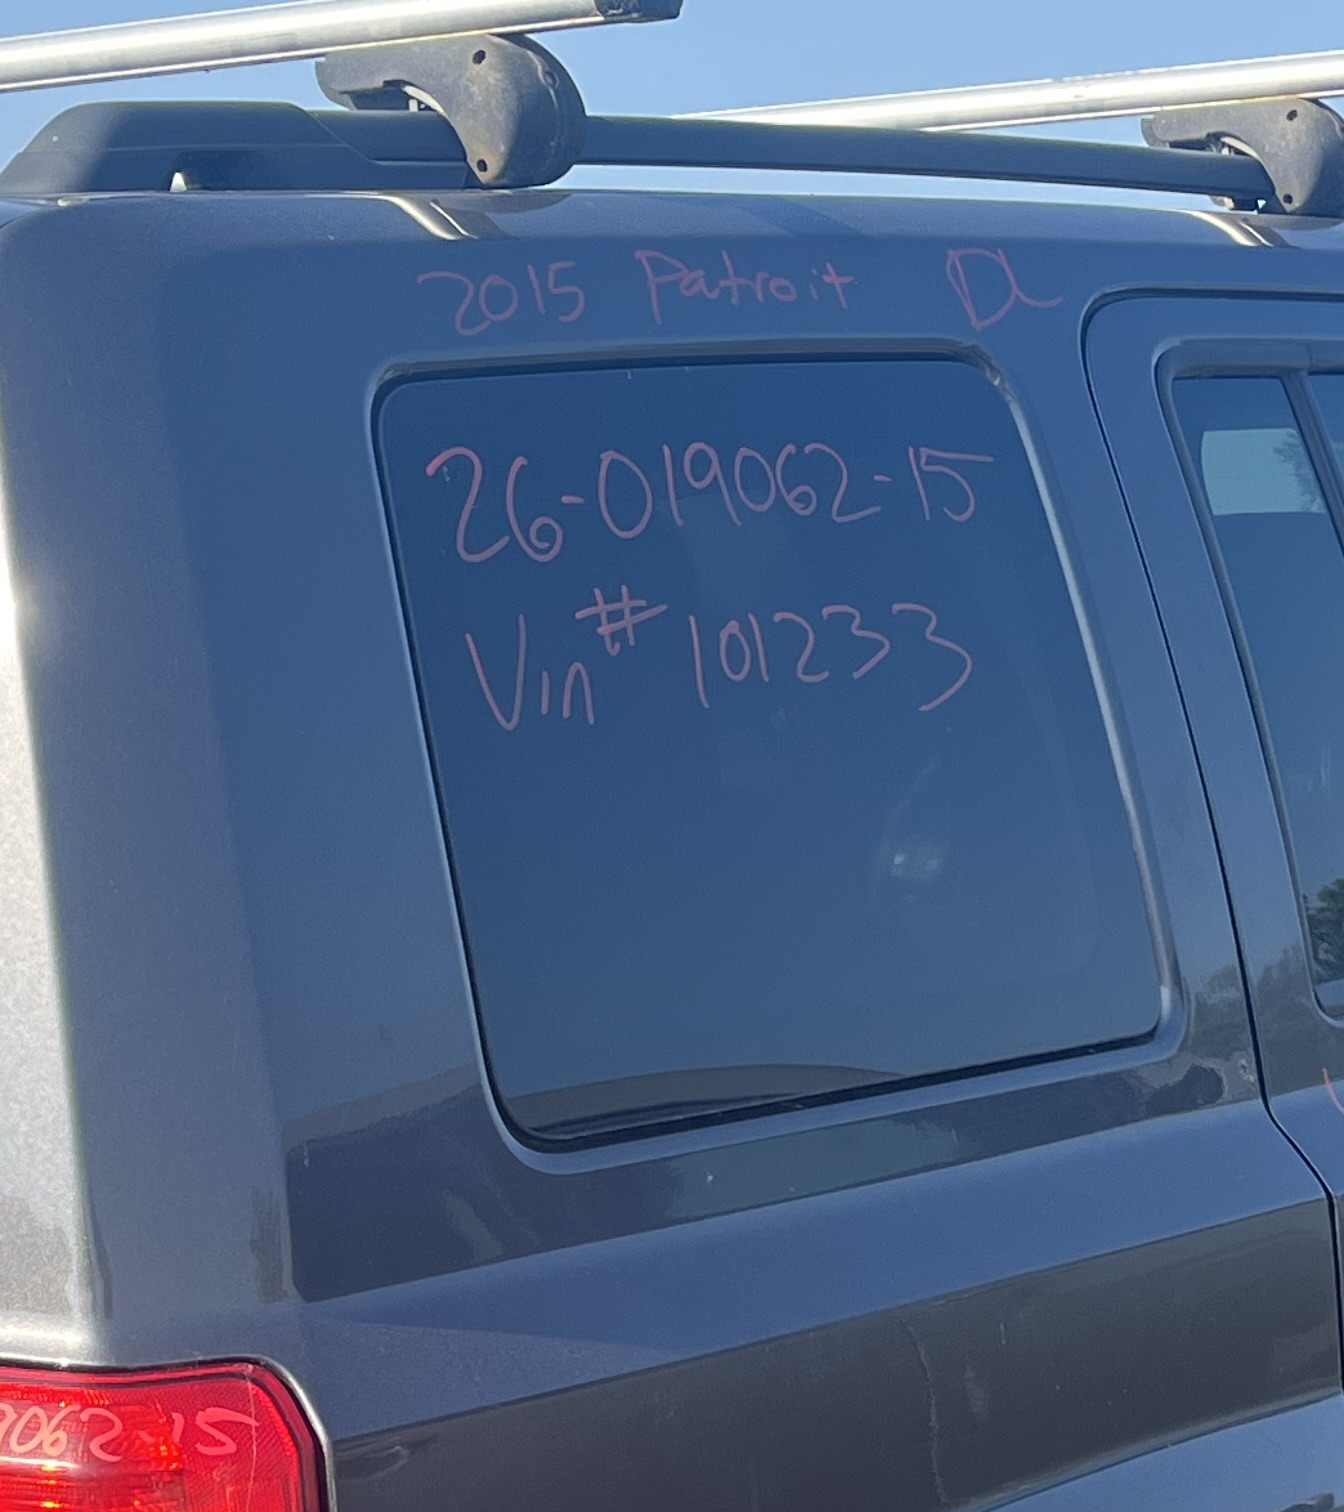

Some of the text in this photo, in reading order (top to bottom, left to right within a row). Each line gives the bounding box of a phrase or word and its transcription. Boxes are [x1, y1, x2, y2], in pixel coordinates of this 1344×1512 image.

[416, 260, 586, 335] 2015
[633, 249, 855, 324] Patroit
[425, 441, 995, 563] 26-019062-15
[688, 602, 973, 711] 101233
